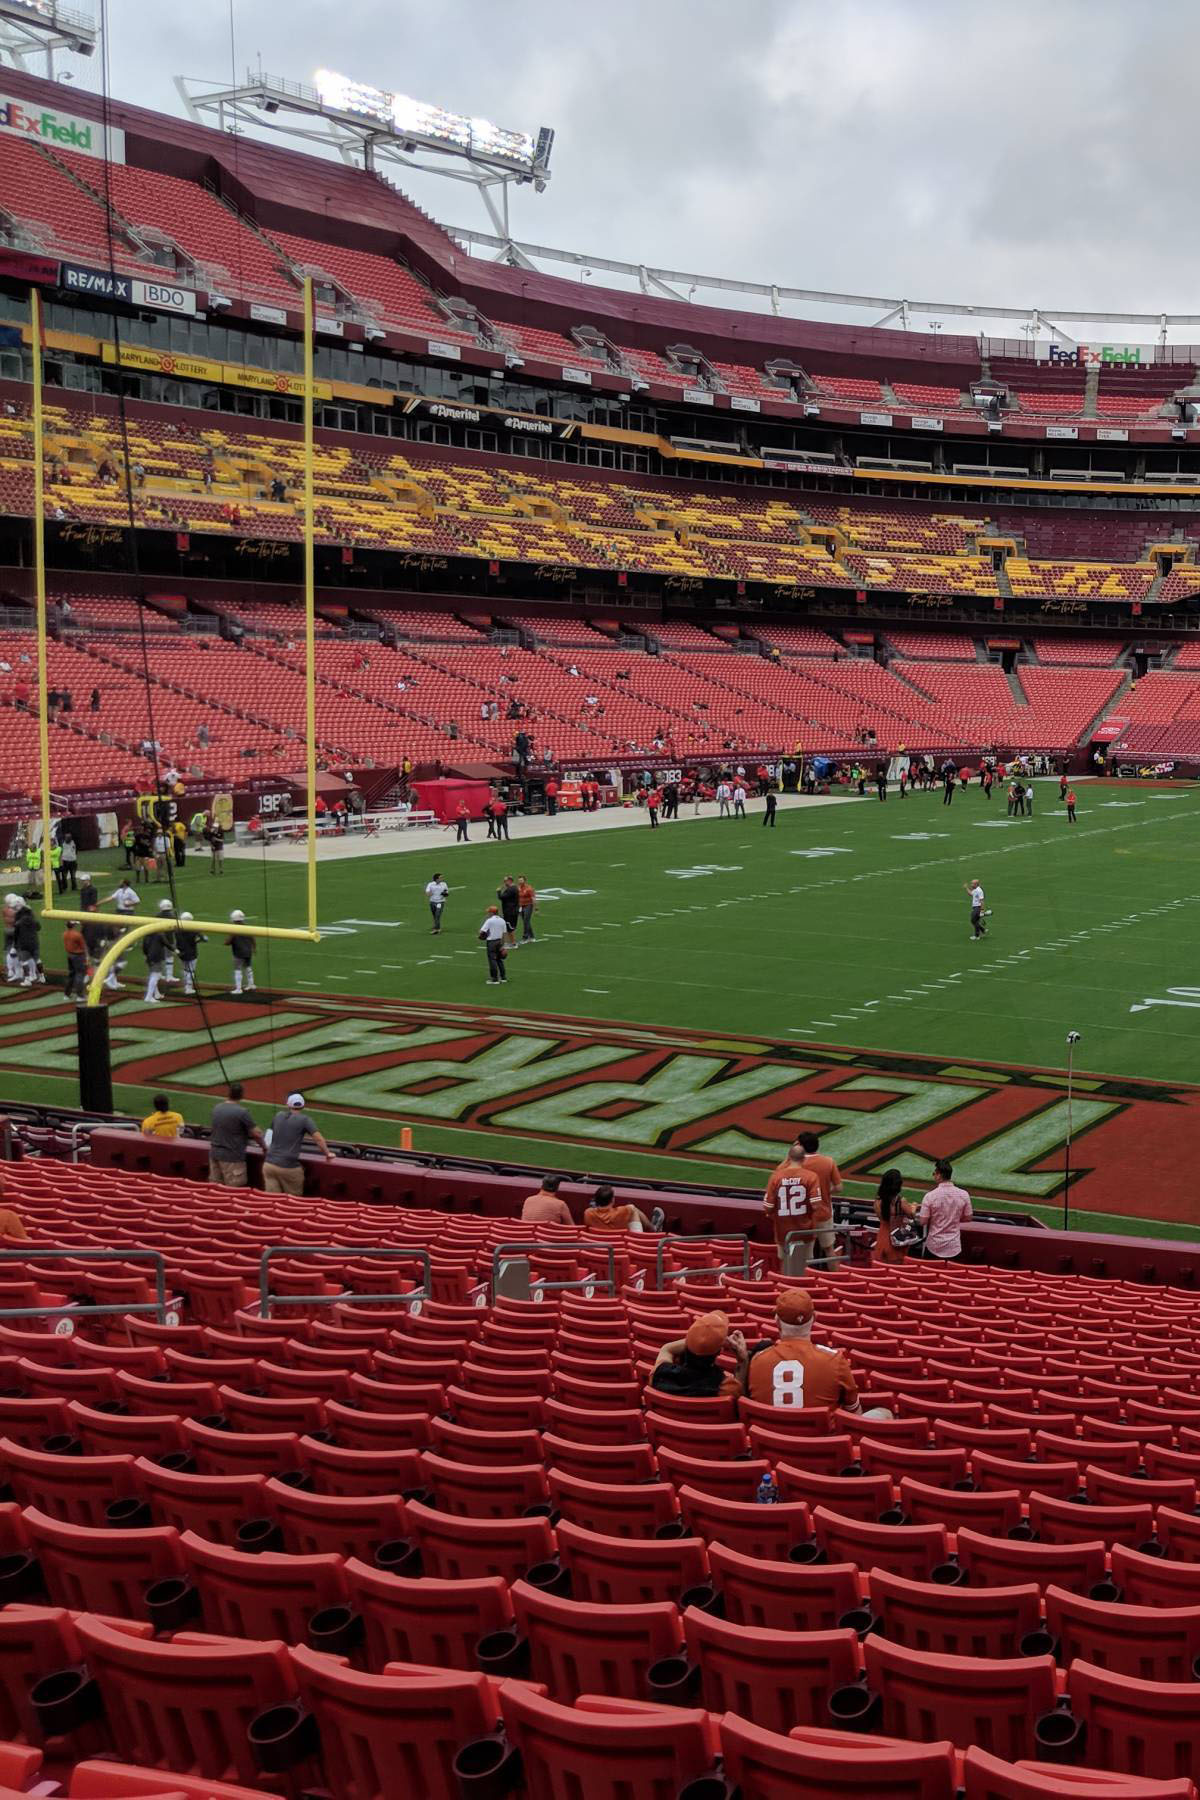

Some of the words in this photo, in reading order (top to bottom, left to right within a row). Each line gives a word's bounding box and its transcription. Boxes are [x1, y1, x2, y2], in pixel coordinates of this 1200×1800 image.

[67, 270, 128, 297] RE/MAX
[148, 285, 184, 306] BDO
[119, 351, 159, 366] MARYLAND
[175, 363, 208, 375] LOTTERY
[1049, 345, 1141, 363] FedExField
[290, 380, 319, 394] LOTTRY
[438, 405, 480, 421] Ameritel
[512, 417, 553, 433] Ameritel
[777, 1185, 808, 1217] 12
[772, 1359, 804, 1409] 8
